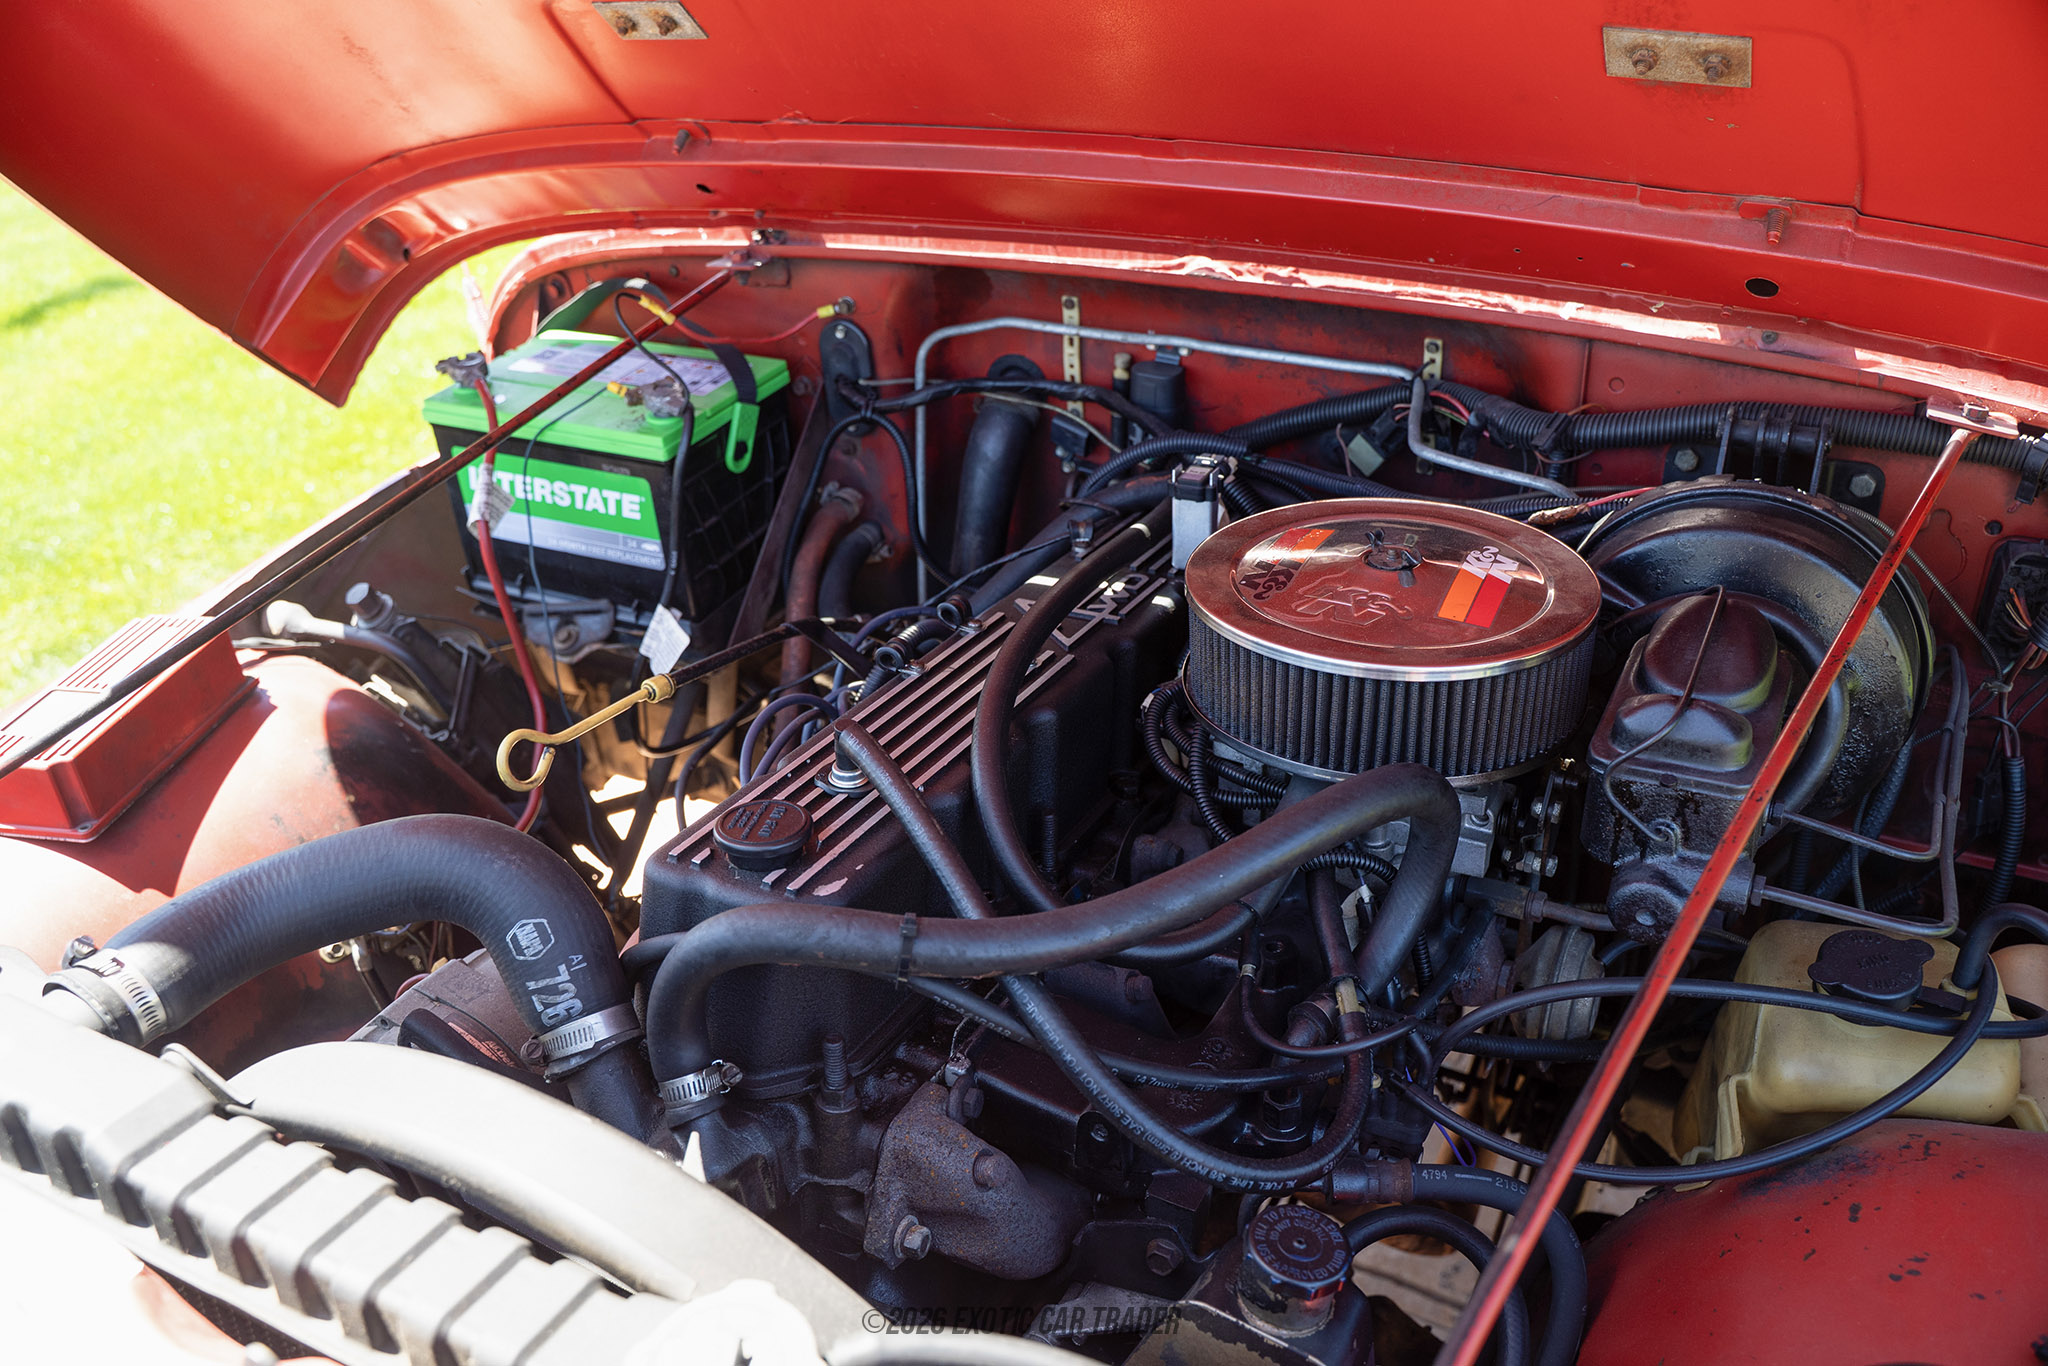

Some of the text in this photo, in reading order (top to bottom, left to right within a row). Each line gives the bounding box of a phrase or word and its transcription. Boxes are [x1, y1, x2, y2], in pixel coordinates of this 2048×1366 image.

[468, 465, 643, 520] ITERSTATE
[606, 547, 663, 567] REPLACEMENT
[1461, 545, 1520, 585] K&N
[1238, 559, 1300, 601] K&N
[515, 922, 544, 957] NAPA
[525, 963, 584, 1028] 726
[1043, 1025, 1064, 1051] FUEL
[1060, 1051, 1080, 1074] FOR
[1080, 1073, 1101, 1097] NOT
[1120, 1112, 1144, 1136] SAE
[1180, 1157, 1208, 1177] INCH
[1421, 1168, 1448, 1180] 4794
[1229, 1176, 1253, 1190] LINE
[1258, 1180, 1283, 1191] FUEL
[1254, 1207, 1345, 1246] FILL TO PROPER LEVEL
[1269, 1218, 1329, 1242] DO NOT OVERFILL
[1256, 1243, 1276, 1264] USE
[1326, 1249, 1347, 1273] FLUID
